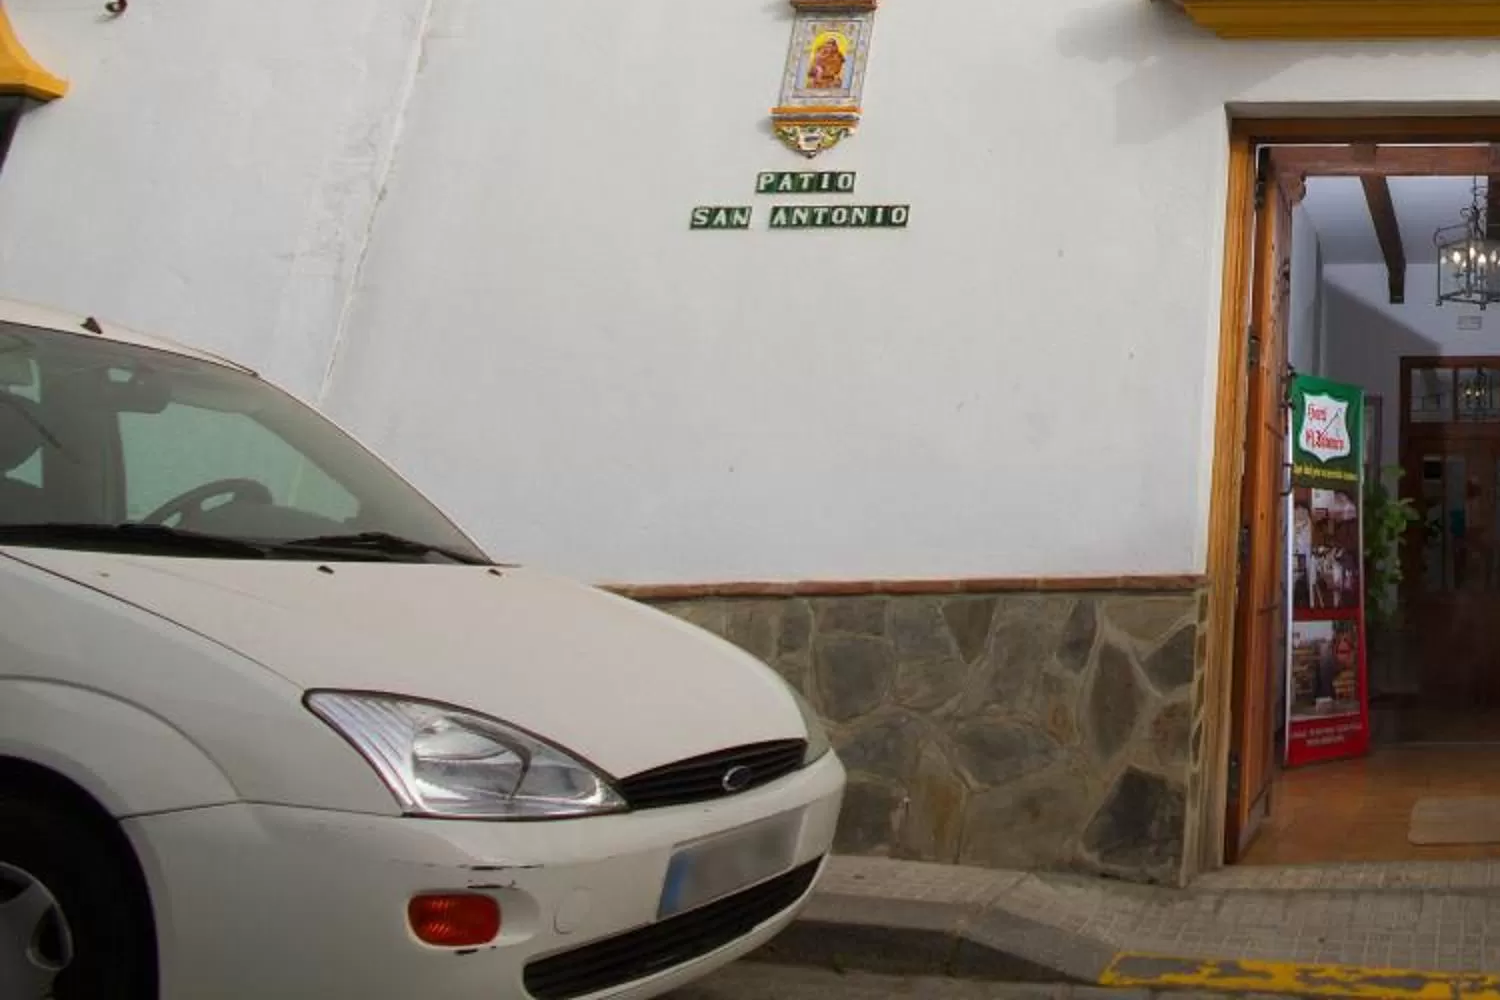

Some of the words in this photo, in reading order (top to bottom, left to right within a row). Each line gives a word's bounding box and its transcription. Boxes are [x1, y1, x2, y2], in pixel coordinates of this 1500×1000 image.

[758, 173, 854, 191] PATIO
[692, 208, 750, 226] SAN
[770, 206, 908, 226] ANTONIO
